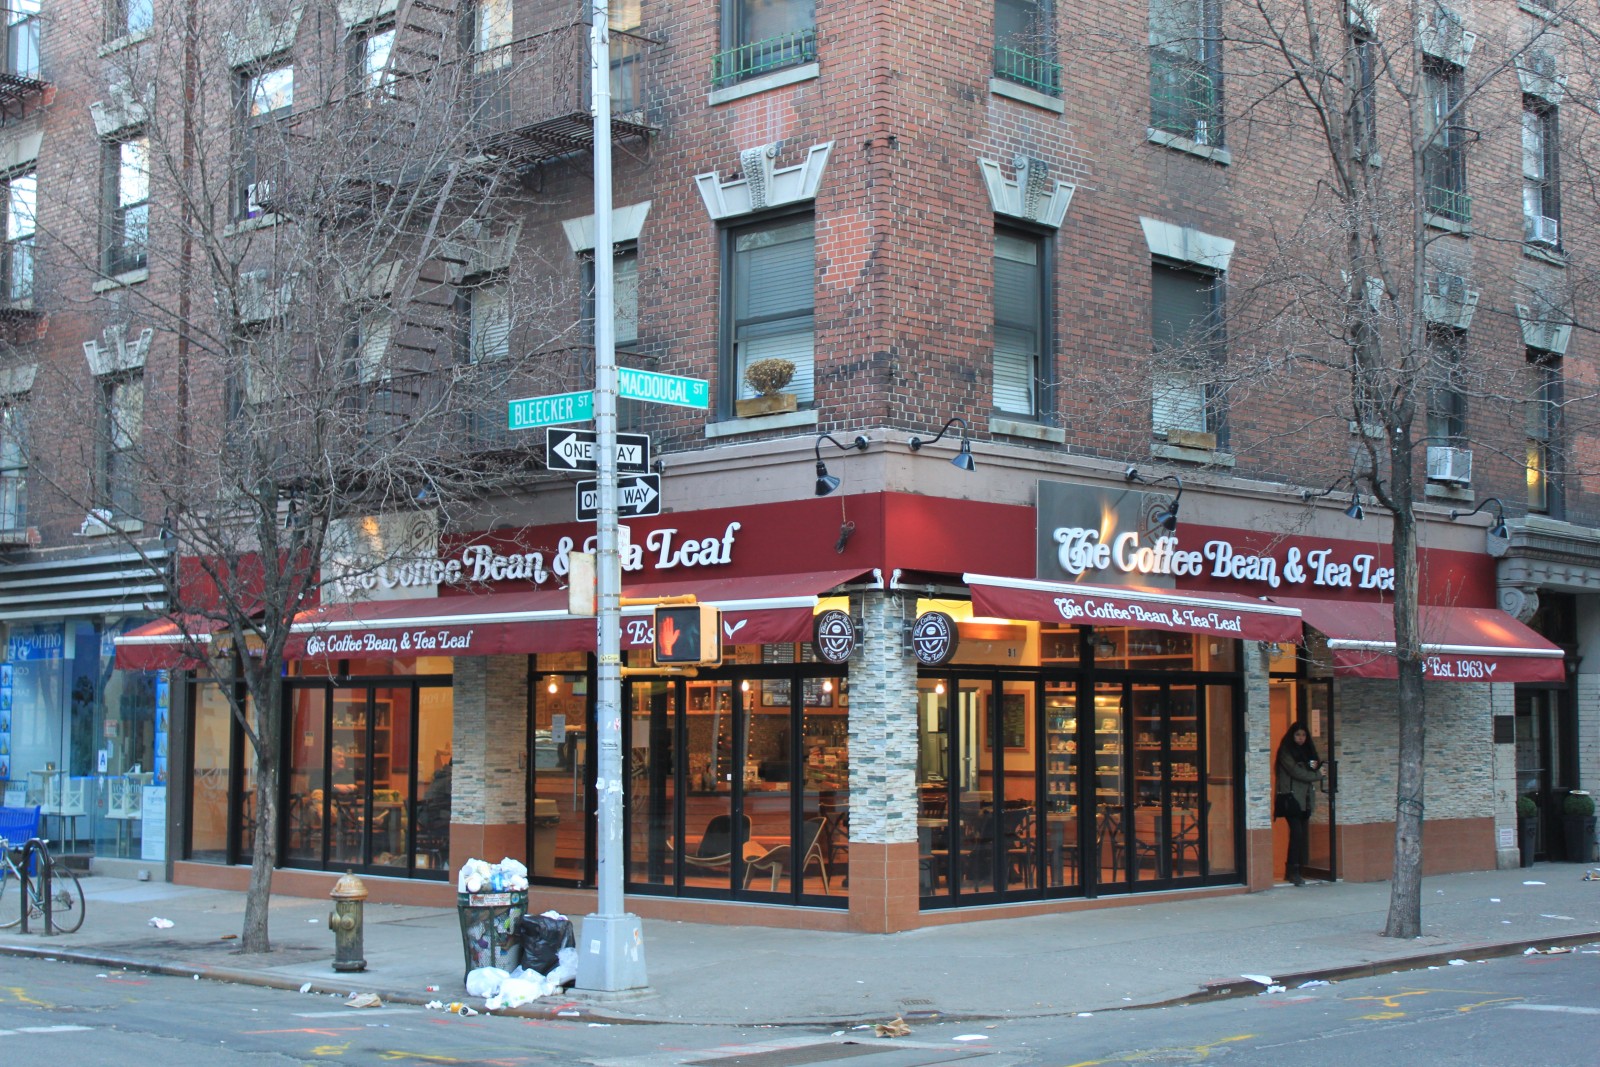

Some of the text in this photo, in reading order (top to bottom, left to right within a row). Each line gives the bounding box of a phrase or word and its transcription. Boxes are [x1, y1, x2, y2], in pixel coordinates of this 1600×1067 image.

[620, 371, 704, 403] MACDOUGAL ST
[514, 395, 589, 426] BLEECKER ST
[563, 443, 635, 462] ONE AY
[584, 487, 650, 508] ON WAY
[463, 544, 548, 584] Bean
[553, 536, 575, 576] &
[645, 521, 742, 570] Leaf
[1052, 527, 1111, 575] The
[1112, 532, 1203, 577] Coffee
[1204, 540, 1281, 588] Bean
[1283, 546, 1307, 584] &
[1307, 548, 1352, 587] Tea
[1054, 597, 1242, 632] The Coffee Bean & Tea Leaf
[327, 634, 363, 652] Coffee
[363, 633, 398, 653] Bean
[400, 632, 412, 650] &
[413, 631, 436, 649] Tea
[438, 630, 474, 649] Leaf
[1427, 656, 1484, 678] Est. 1963
